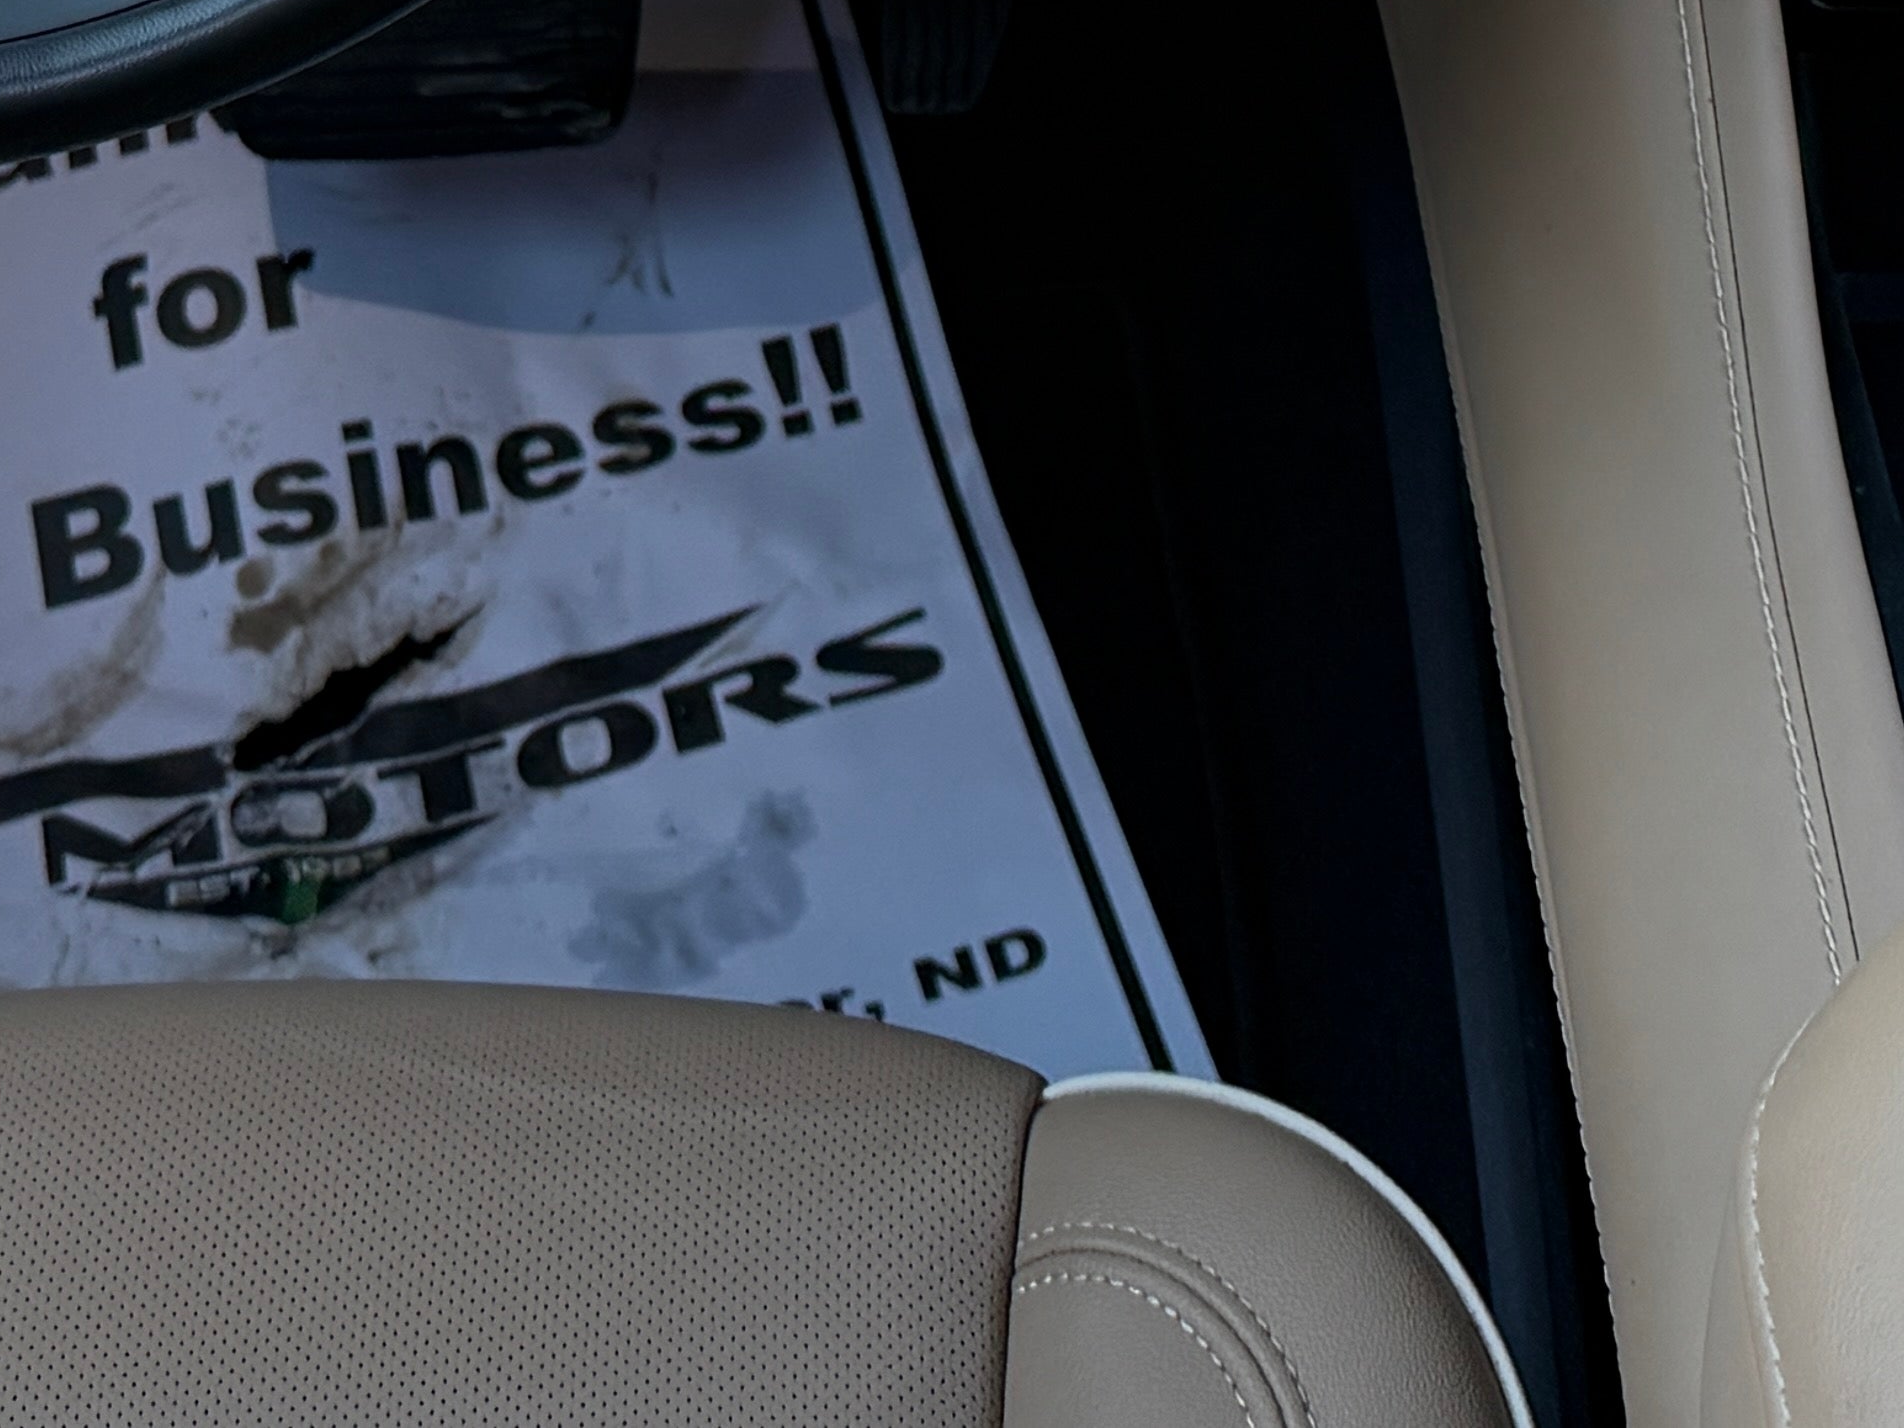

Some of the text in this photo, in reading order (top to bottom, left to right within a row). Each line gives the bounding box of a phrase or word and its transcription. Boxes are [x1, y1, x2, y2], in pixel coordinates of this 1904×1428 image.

[91, 246, 315, 372] for
[31, 324, 863, 610] Business!!
[42, 607, 942, 894] MOTORS
[912, 927, 1048, 1002] ND
